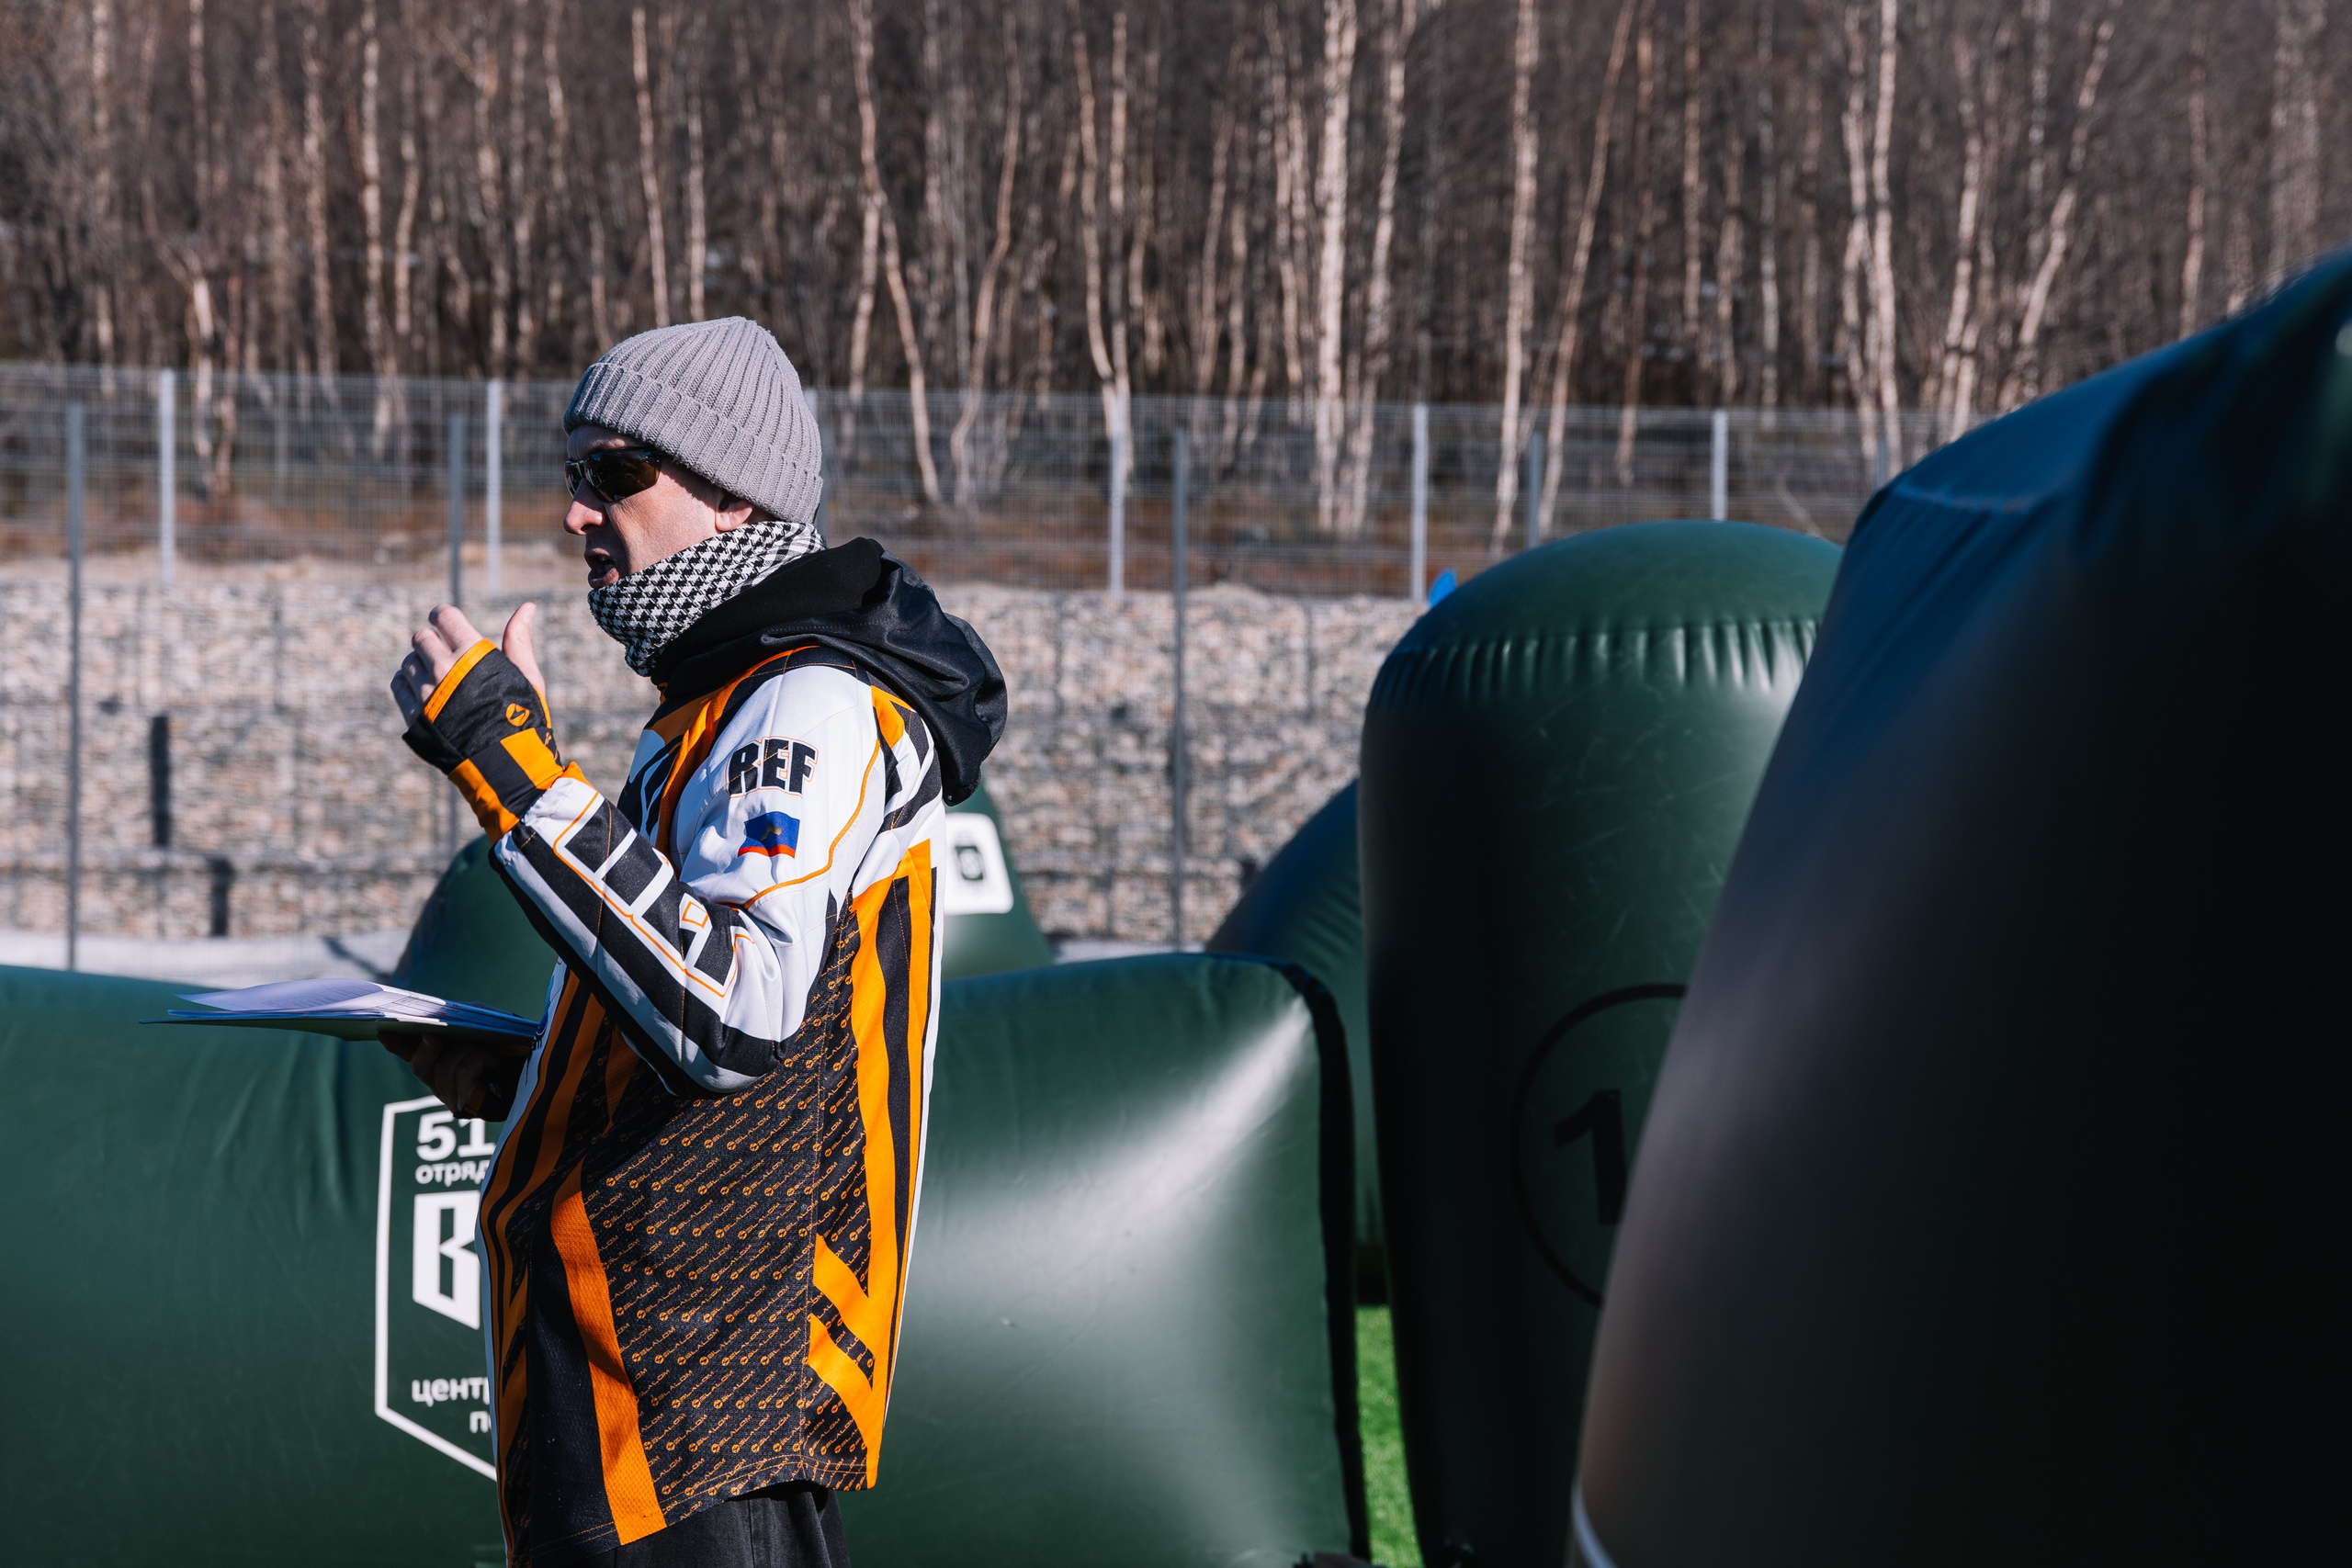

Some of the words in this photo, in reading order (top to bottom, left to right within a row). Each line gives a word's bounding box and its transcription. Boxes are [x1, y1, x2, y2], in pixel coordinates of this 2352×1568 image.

[729, 738, 816, 795] REF
[741, 1070, 777, 1100] SLALOM
[763, 1072, 798, 1102] SLALOM
[416, 1110, 496, 1161] 51
[690, 1110, 726, 1141] SLALOM
[712, 1111, 749, 1143] SLALOM
[735, 1113, 771, 1145] SLALOM
[757, 1114, 792, 1145] SLALOM
[831, 1115, 859, 1150] SLALOM
[615, 1152, 651, 1181] SLALOM
[638, 1152, 674, 1183] SLALOM
[660, 1154, 697, 1185] SLALOM
[683, 1156, 719, 1187] SLALOM
[707, 1157, 742, 1189] SLALOM
[729, 1158, 764, 1189] SLALOM
[751, 1157, 785, 1190] SLALOM
[773, 1157, 806, 1190] SLALOM
[828, 1159, 858, 1194] SLALOM
[589, 1191, 622, 1221] SLALOM
[654, 1198, 691, 1228] SLALOM
[677, 1199, 713, 1229] SLALOM
[700, 1199, 735, 1230] SLALOM
[723, 1200, 759, 1232] SLALOM
[746, 1201, 780, 1234] SLALOM
[764, 1199, 797, 1231] SLALOM
[837, 1201, 866, 1235] SLALOM
[674, 1242, 708, 1271] SLALOM
[696, 1243, 731, 1274] SLALOM
[718, 1243, 752, 1275] SLALOM
[738, 1241, 772, 1274] SLALOM
[758, 1241, 792, 1273] SLALOM
[623, 1280, 660, 1311] SLALOM
[645, 1283, 681, 1313] SLALOM
[667, 1286, 704, 1314] SLALOM
[689, 1284, 723, 1315] SLALOM
[711, 1283, 744, 1316] SLALOM
[733, 1284, 766, 1316] SLALOM
[755, 1284, 790, 1316] SLALOM
[775, 1280, 808, 1315] SLALOM
[639, 1325, 675, 1356] SLALOM
[662, 1326, 698, 1358] SLALOM
[685, 1327, 719, 1359] SLALOM
[707, 1327, 741, 1359] SLALOM
[729, 1327, 763, 1359] SLALOM
[747, 1325, 780, 1359] SLALOM
[679, 1371, 714, 1402] SLALOM
[699, 1369, 733, 1402] SLALOM
[721, 1370, 754, 1403] SLALOM
[743, 1370, 777, 1403] SLALOM
[765, 1370, 797, 1404] SLALOM
[651, 1412, 686, 1444] SLALOM
[673, 1413, 707, 1445] SLALOM
[696, 1413, 730, 1446] SLALOM
[718, 1414, 752, 1447] SLALOM
[739, 1413, 770, 1446] SLALOM
[758, 1412, 791, 1446] SLALOM
[670, 1457, 705, 1489] SLALOM
